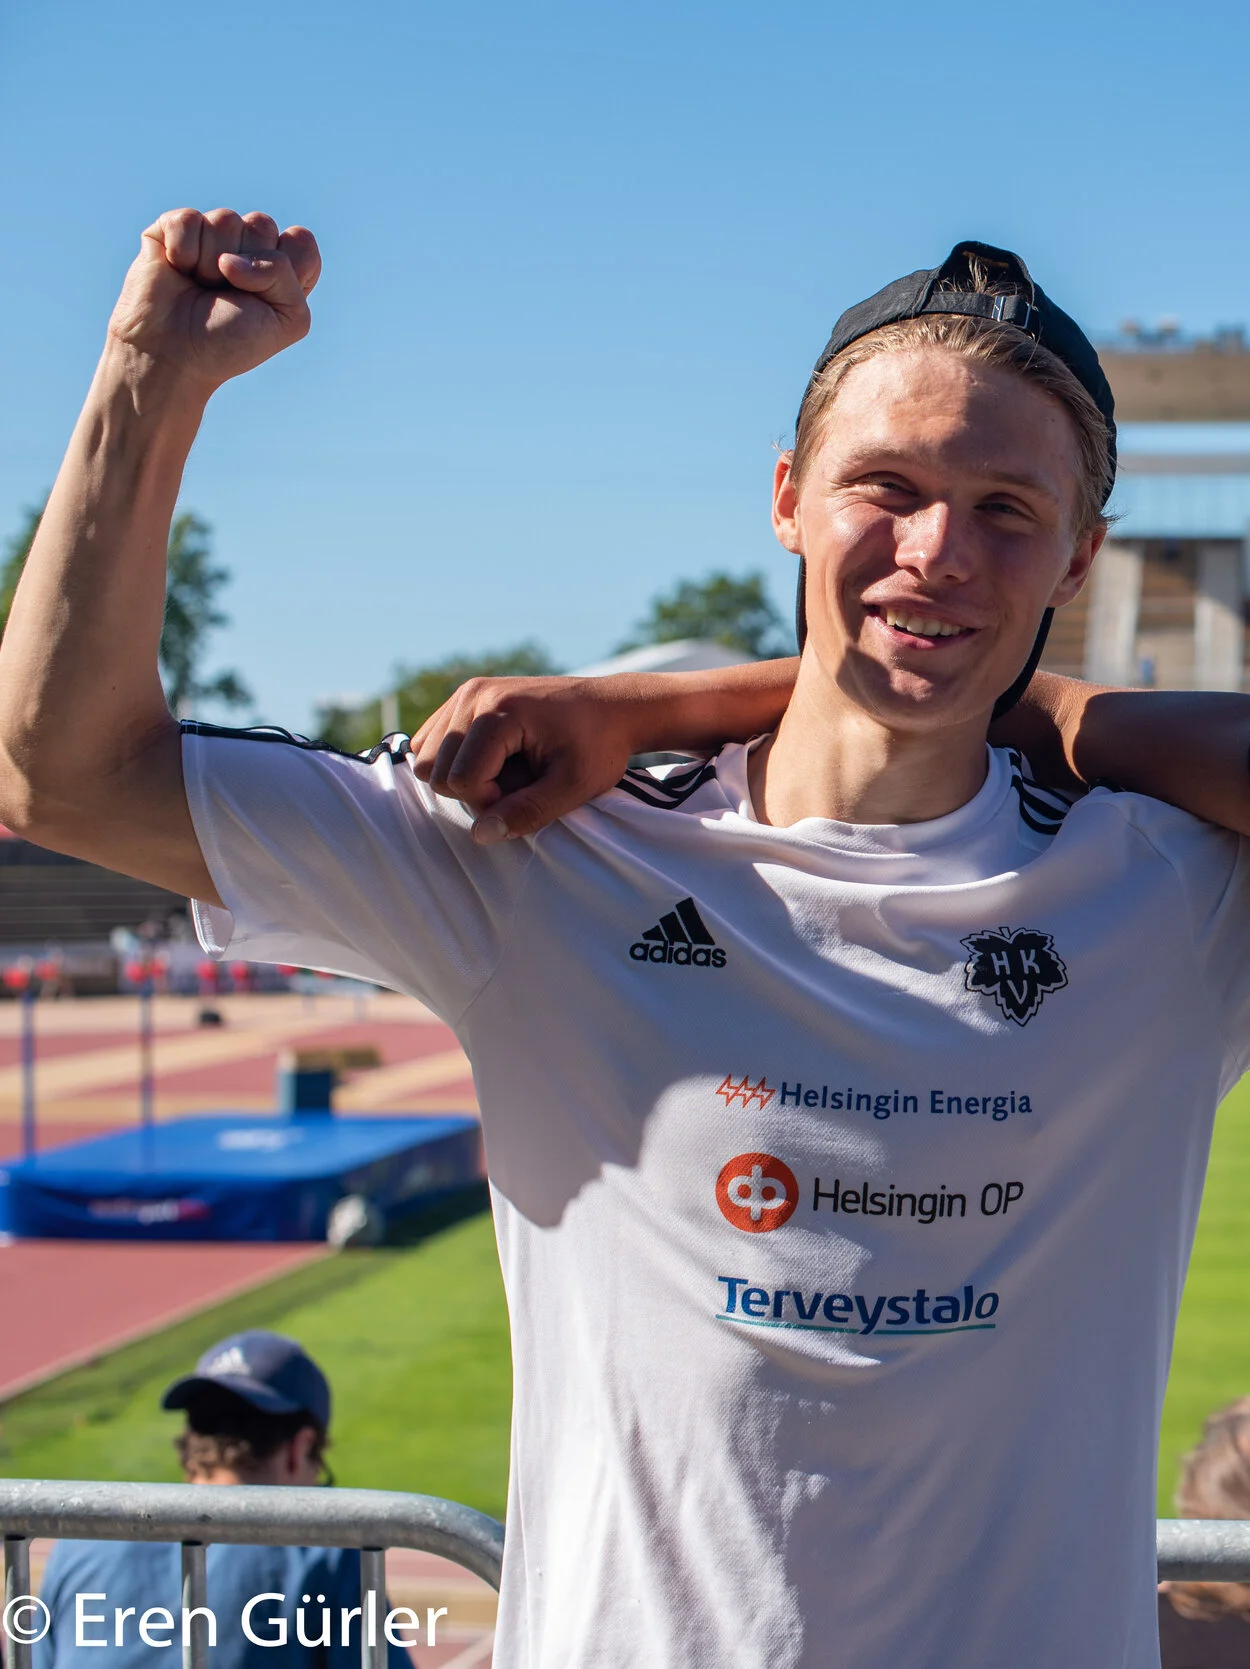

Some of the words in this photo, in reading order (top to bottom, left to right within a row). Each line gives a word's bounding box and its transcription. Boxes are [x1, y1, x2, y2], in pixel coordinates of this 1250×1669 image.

[628, 939, 728, 969] adidas
[779, 1082, 919, 1120] Helsingin
[930, 1090, 1033, 1121] Energia
[812, 1176, 967, 1225] Helsingin
[980, 1181, 1024, 1216] OP
[716, 1275, 999, 1335] Terveystalo
